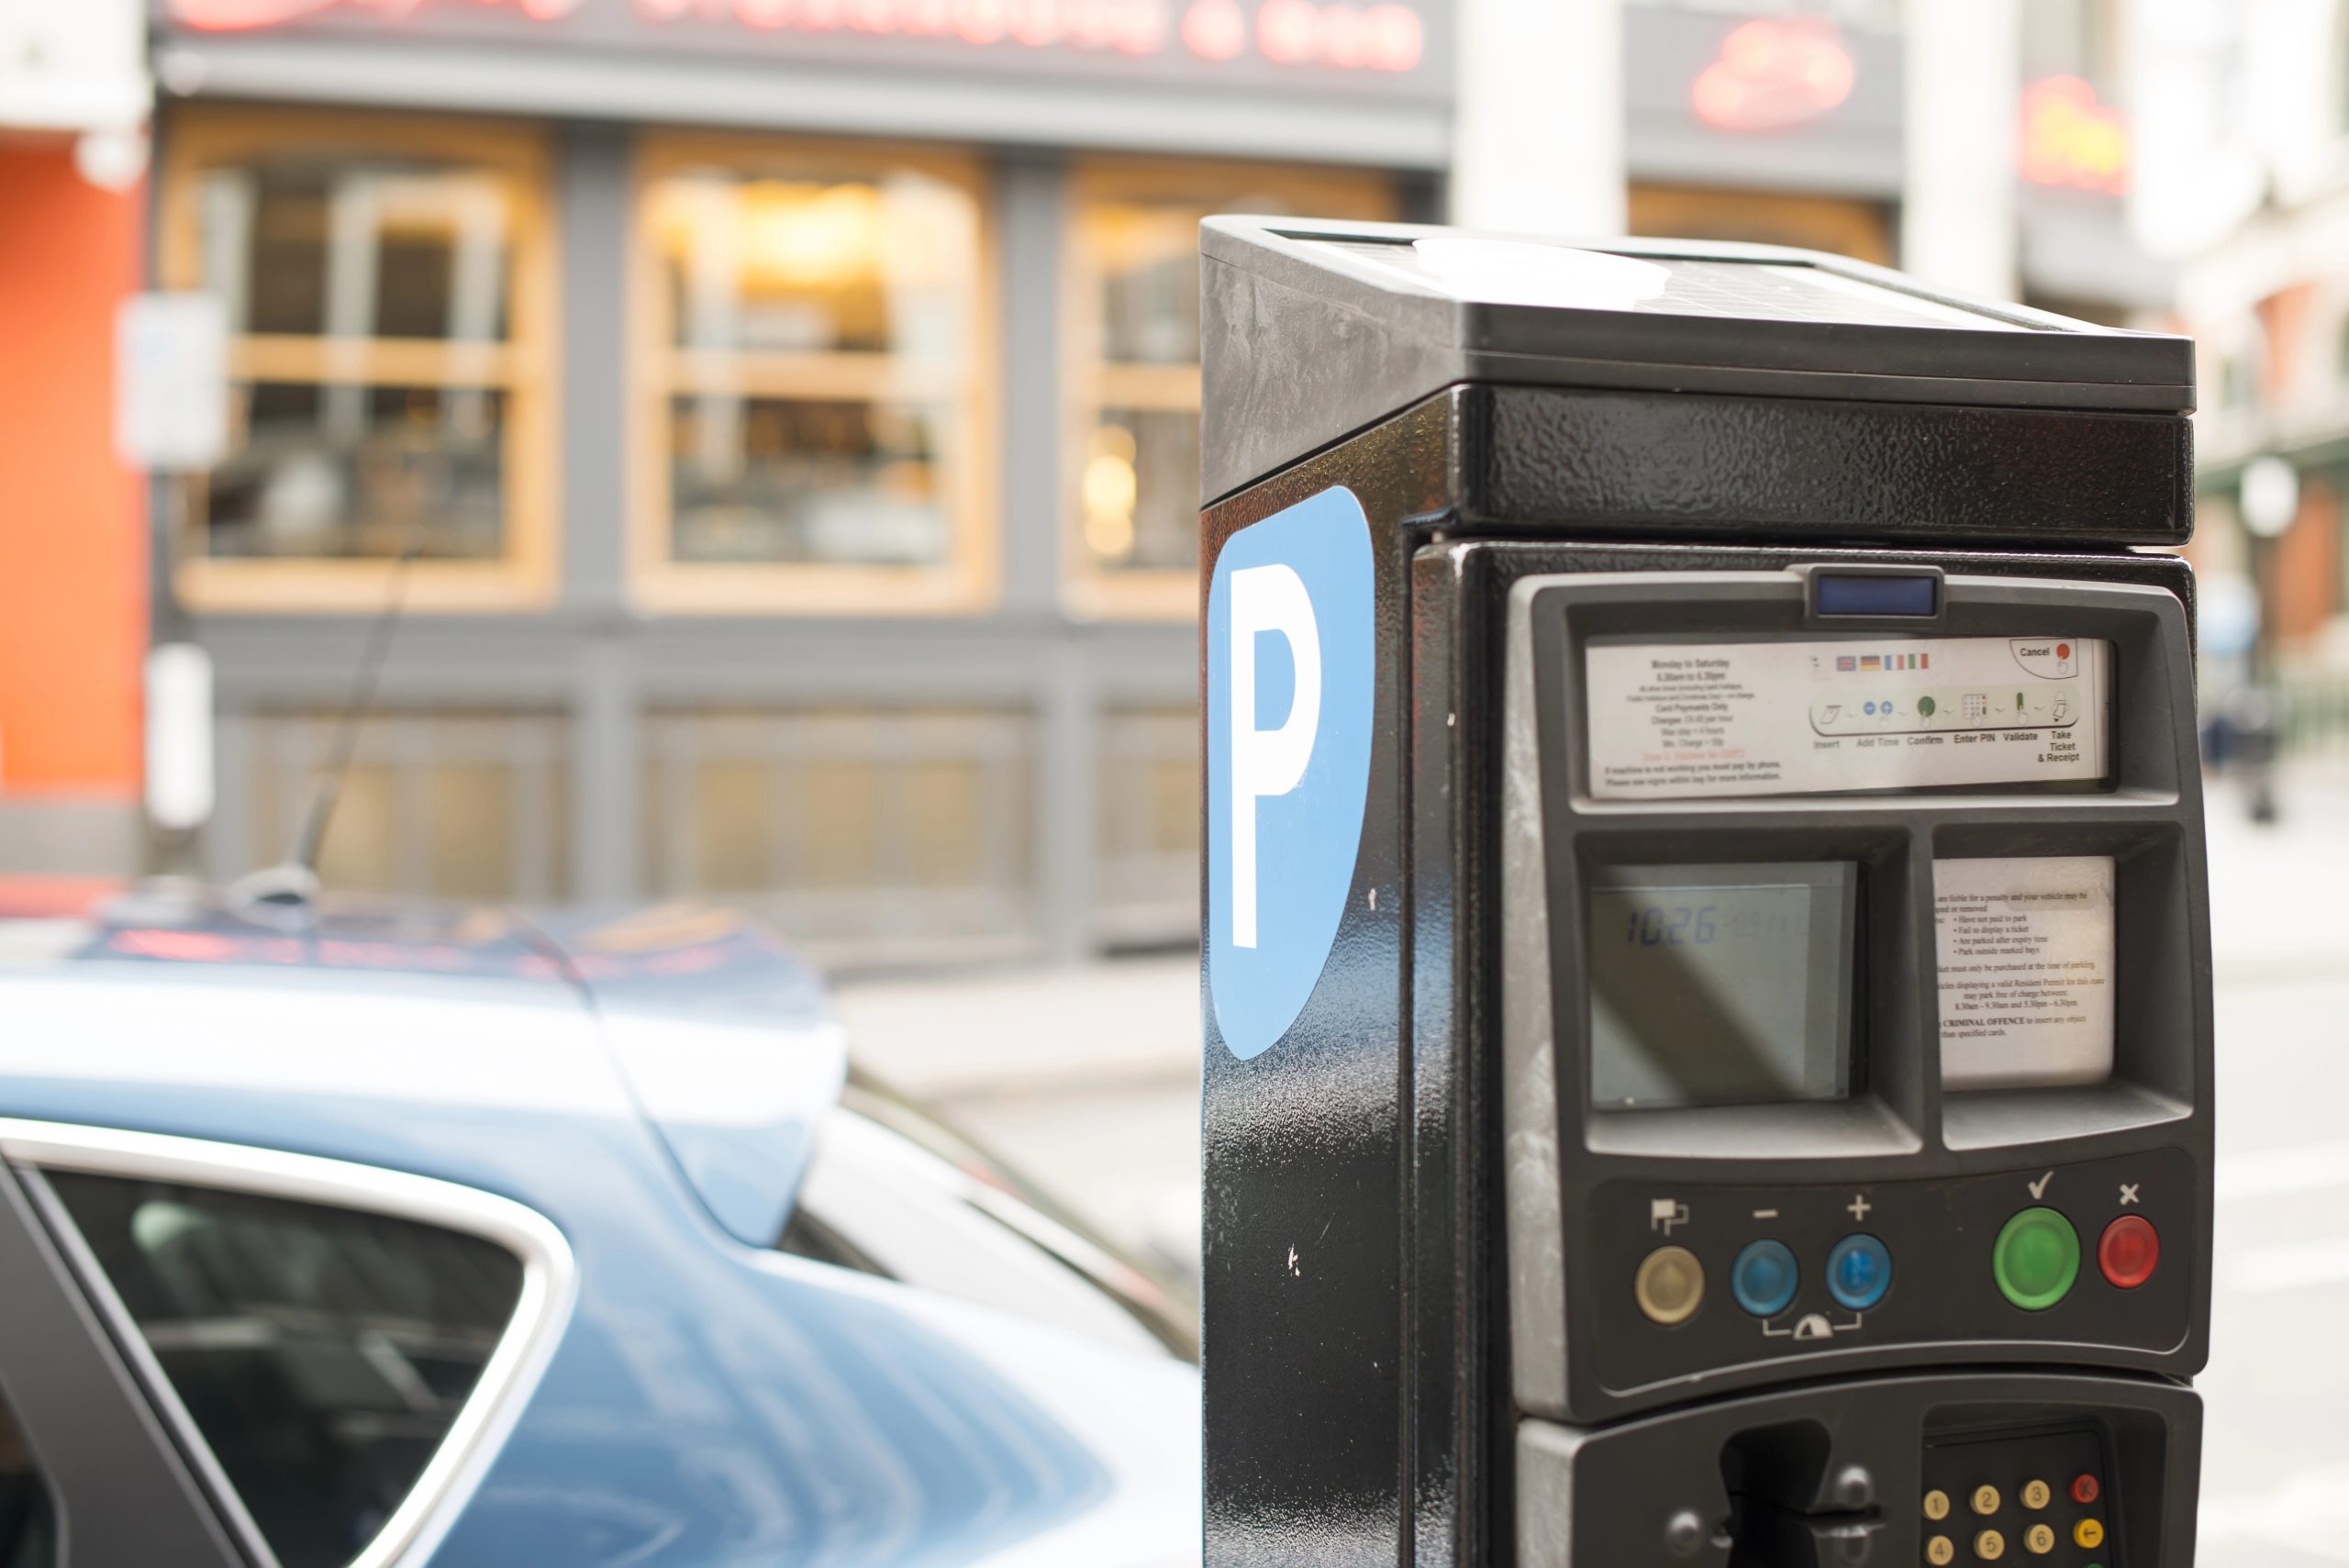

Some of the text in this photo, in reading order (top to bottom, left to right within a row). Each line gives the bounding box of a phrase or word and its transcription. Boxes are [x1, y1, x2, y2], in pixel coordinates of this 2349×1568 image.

[2020, 648, 2050, 657] Cancel
[1651, 660, 1682, 670] Monday
[1695, 659, 1730, 669] Saturday
[1675, 704, 1709, 713] Payments
[1954, 734, 1996, 743] Enter PIN
[2003, 733, 2038, 741] Validate
[2052, 731, 2071, 740] Take
[1814, 740, 1840, 749] Insert
[1856, 738, 1899, 747] Add Time
[1908, 736, 1943, 745] Confirm
[2050, 742, 2076, 751] Ticket
[1230, 563, 1321, 949] P
[2038, 753, 2080, 762] & Receipt
[1986, 894, 2009, 903] penalty
[2023, 895, 2039, 903] your
[2041, 892, 2063, 900] vehicle
[1958, 916, 1976, 924] Have
[1989, 915, 2003, 924] paid
[2013, 915, 2027, 924] park
[1981, 925, 2003, 935] display
[1973, 936, 1994, 945] parked
[1996, 936, 2010, 944] after
[2012, 936, 2032, 945] expiry
[1958, 947, 1974, 955] Park
[1975, 947, 1998, 955] outside
[2000, 946, 2023, 954] marked
[1994, 962, 2026, 972] purchased
[2036, 962, 2045, 970] the
[1956, 980, 1989, 990] displaying
[1997, 979, 2012, 987] valid
[2015, 979, 2042, 987] Resident
[2043, 978, 2064, 986] Permit
[1979, 991, 1993, 1000] park
[1996, 990, 2008, 998] free
[2019, 989, 2039, 998] charge
[1943, 1018, 1985, 1028] CRIMINAL
[1987, 1017, 2024, 1026] OFFENCE
[1957, 1029, 1987, 1039] specified
[1982, 1492, 1992, 1507] 2
[2032, 1486, 2042, 1501] 3
[1934, 1531, 2047, 1557] 4 5 6
